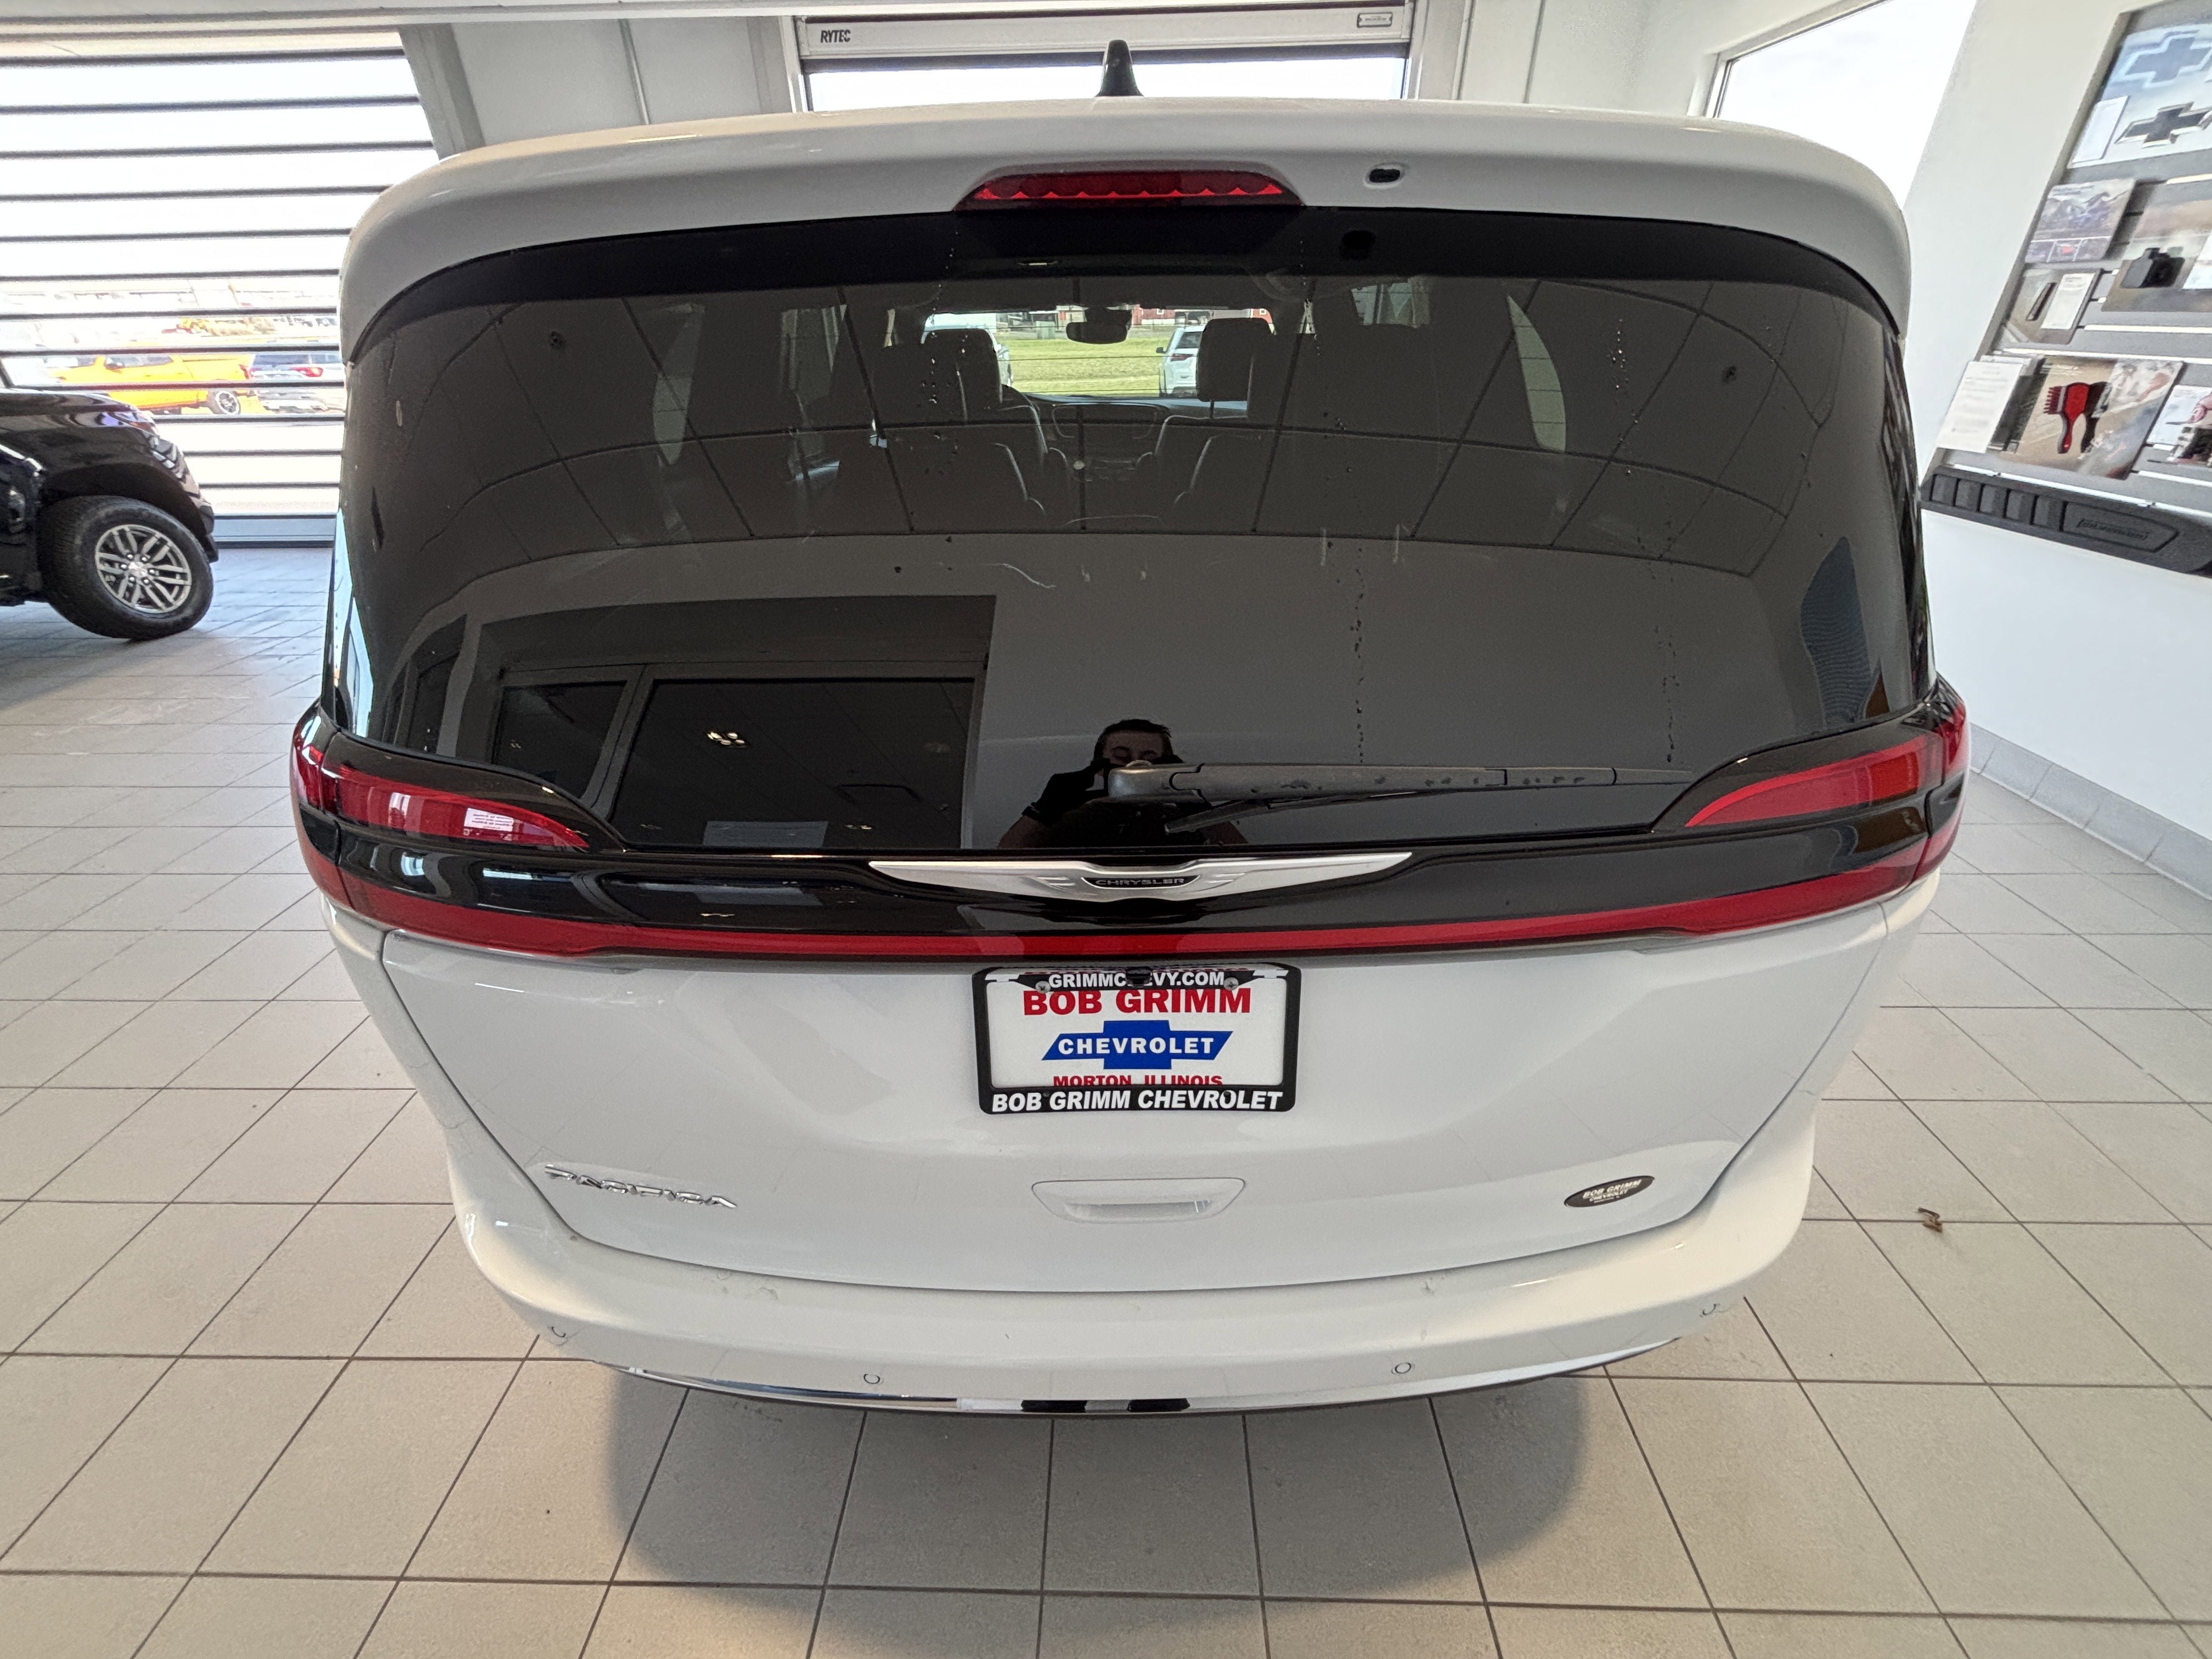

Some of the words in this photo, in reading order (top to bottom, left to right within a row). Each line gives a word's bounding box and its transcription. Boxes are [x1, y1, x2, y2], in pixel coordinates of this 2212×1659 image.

[821, 30, 851, 43] RYTEC
[1048, 972, 1224, 988] GRIMMCVY.COM
[1024, 990, 1102, 1015] BOB
[1116, 988, 1250, 1013] GRIMM
[1058, 1037, 1214, 1054] CHEVROLET
[992, 1093, 1042, 1112] BOB
[1049, 1091, 1130, 1110] GRIMM
[1138, 1090, 1283, 1110] CHEVROLET
